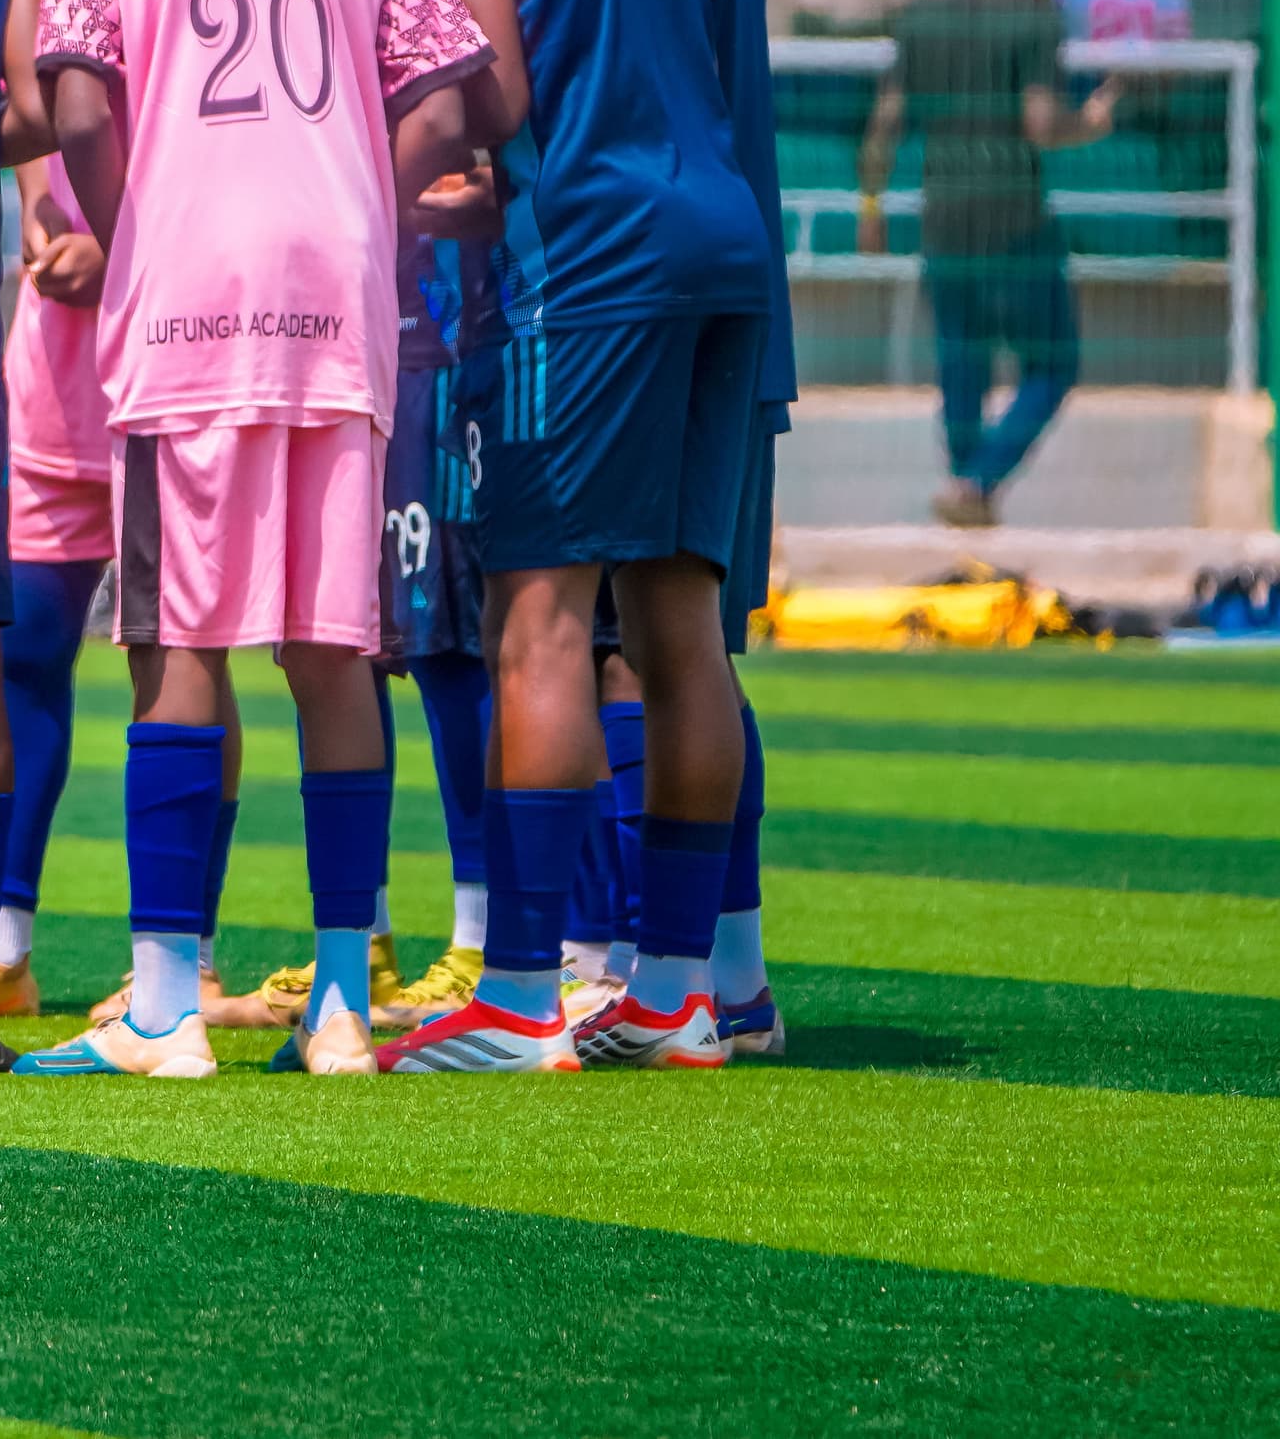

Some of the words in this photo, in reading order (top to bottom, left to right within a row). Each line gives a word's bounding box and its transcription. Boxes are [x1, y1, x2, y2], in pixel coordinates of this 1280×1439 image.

[146, 313, 244, 346] LUFUNGA
[248, 312, 344, 341] ACADEMY
[385, 501, 431, 579] 29
